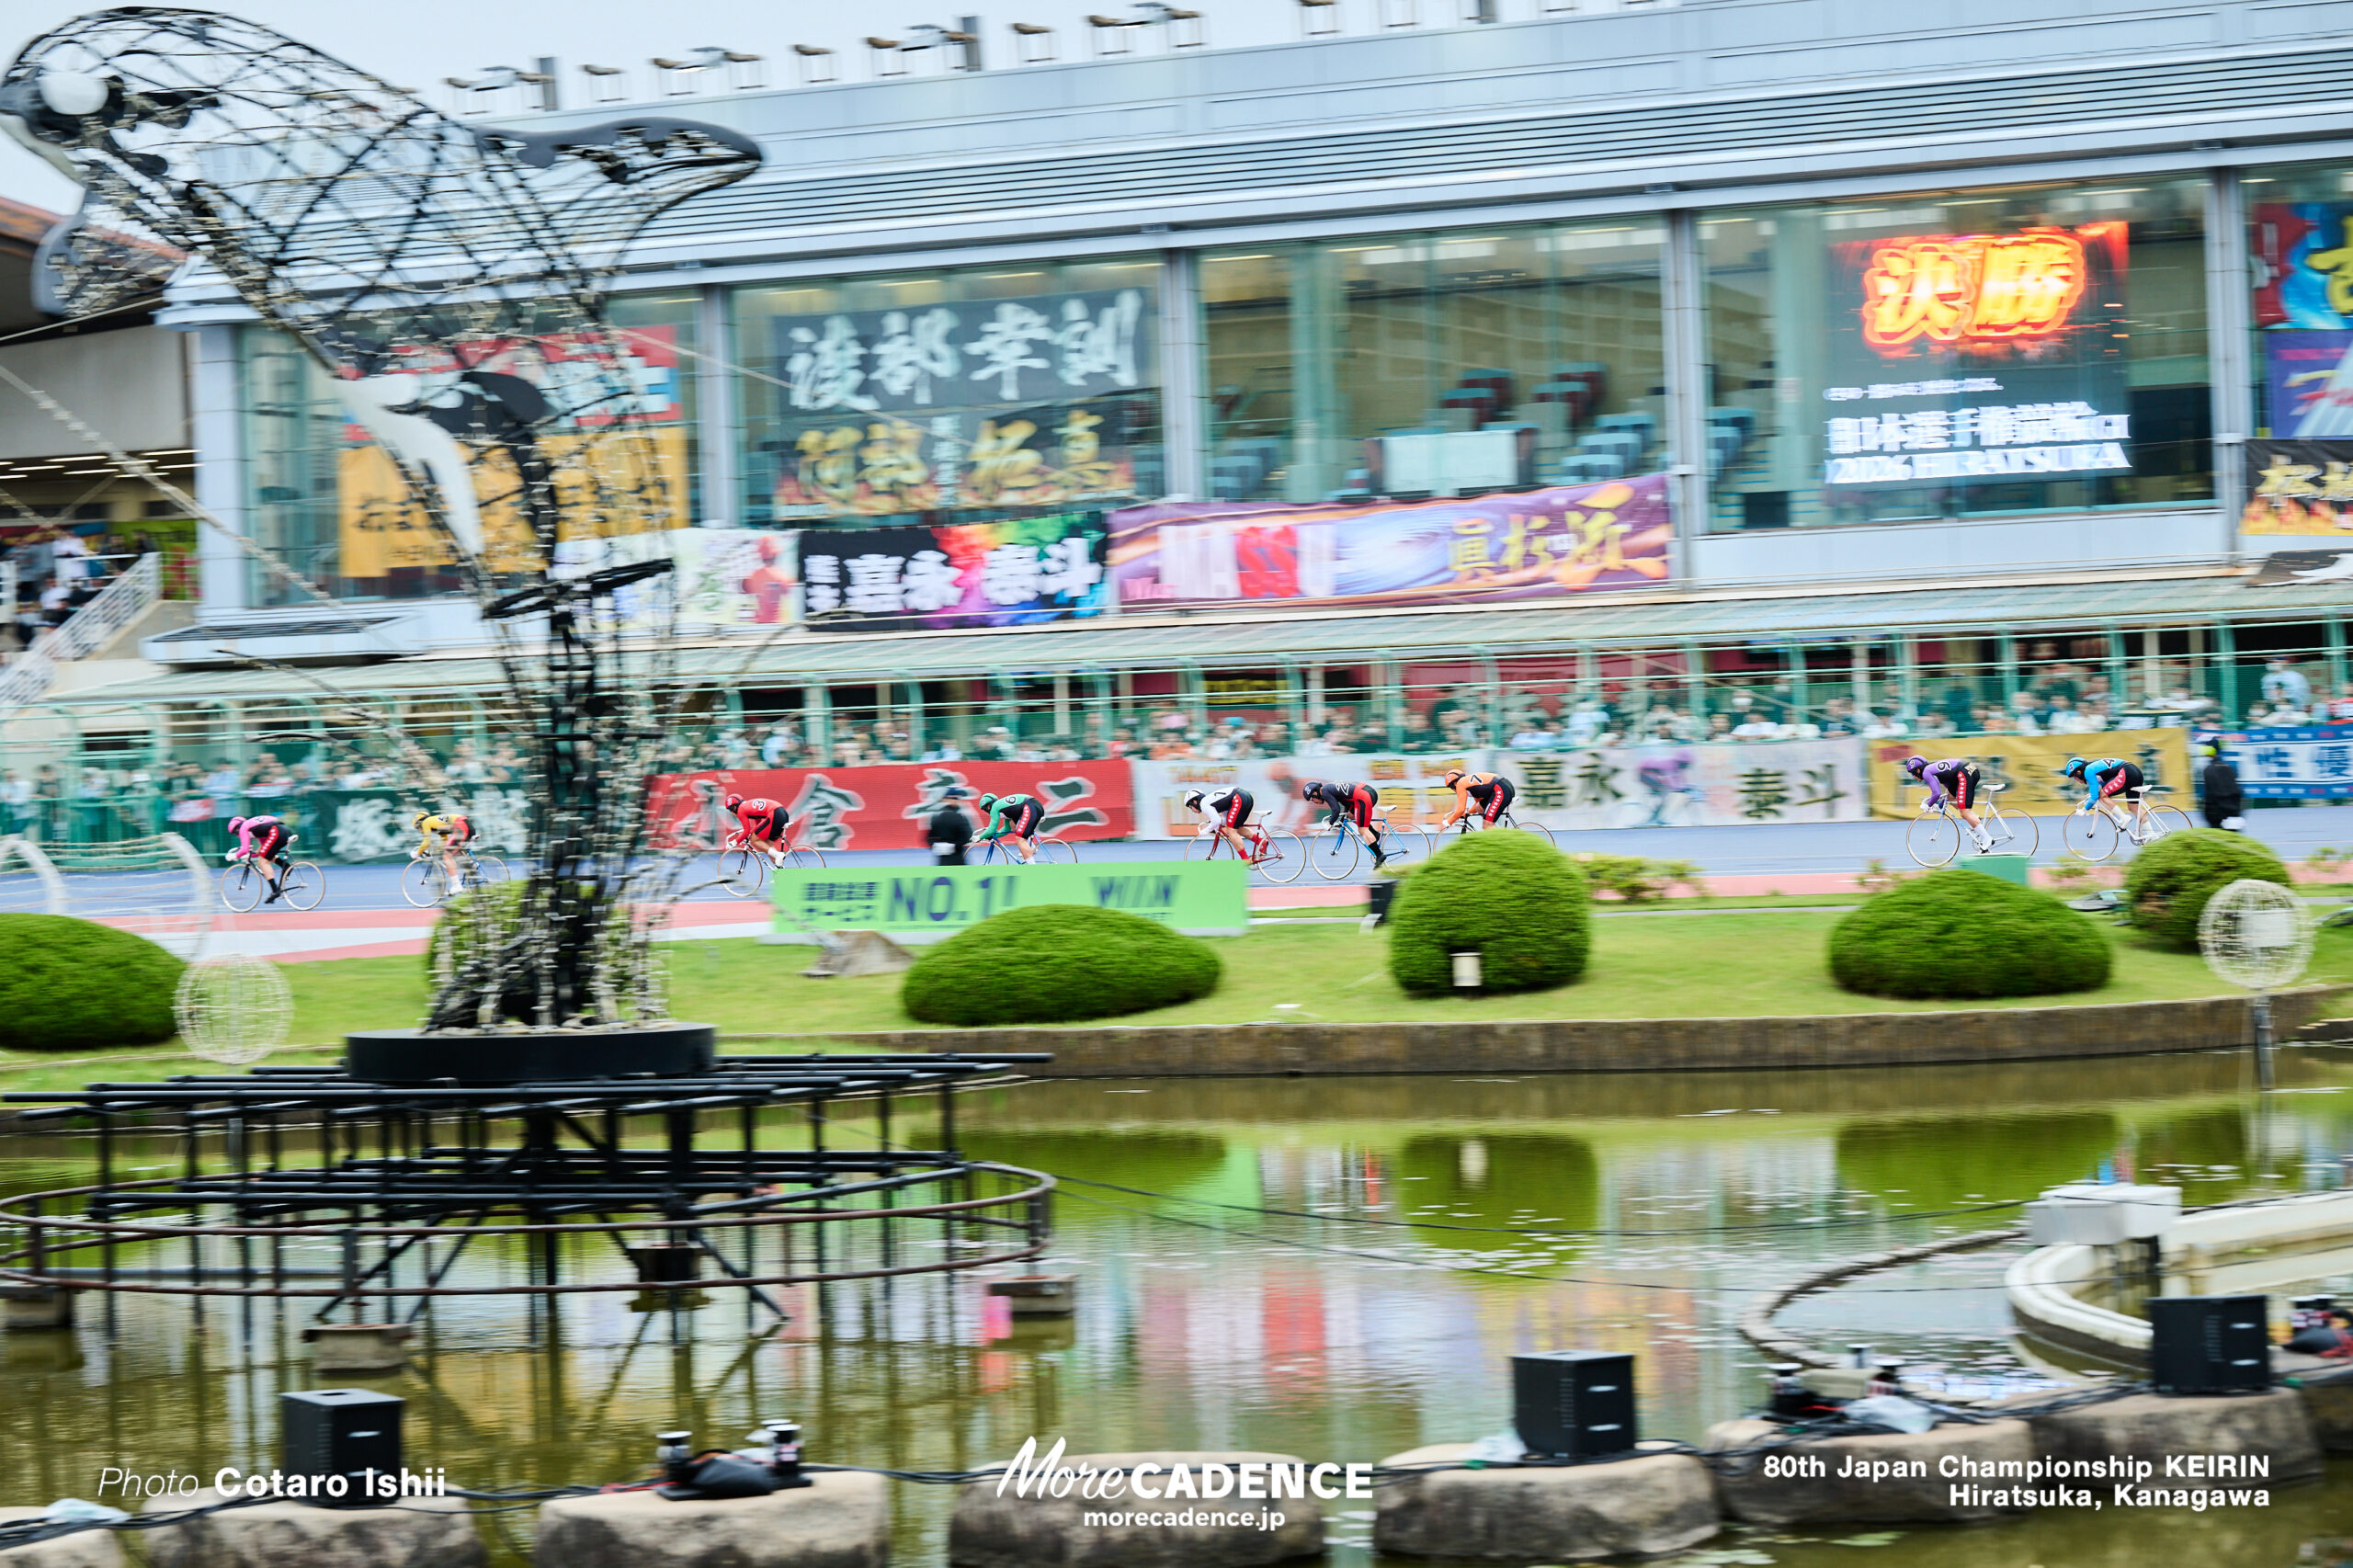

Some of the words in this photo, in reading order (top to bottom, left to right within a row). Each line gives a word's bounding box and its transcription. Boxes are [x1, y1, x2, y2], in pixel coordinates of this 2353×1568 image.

[1866, 233, 2084, 344] 決勝
[1937, 761, 1951, 772] 9
[1470, 774, 1483, 786] 7
[1336, 780, 1350, 796] 2
[752, 800, 767, 811] 3
[1005, 796, 1017, 806] 6
